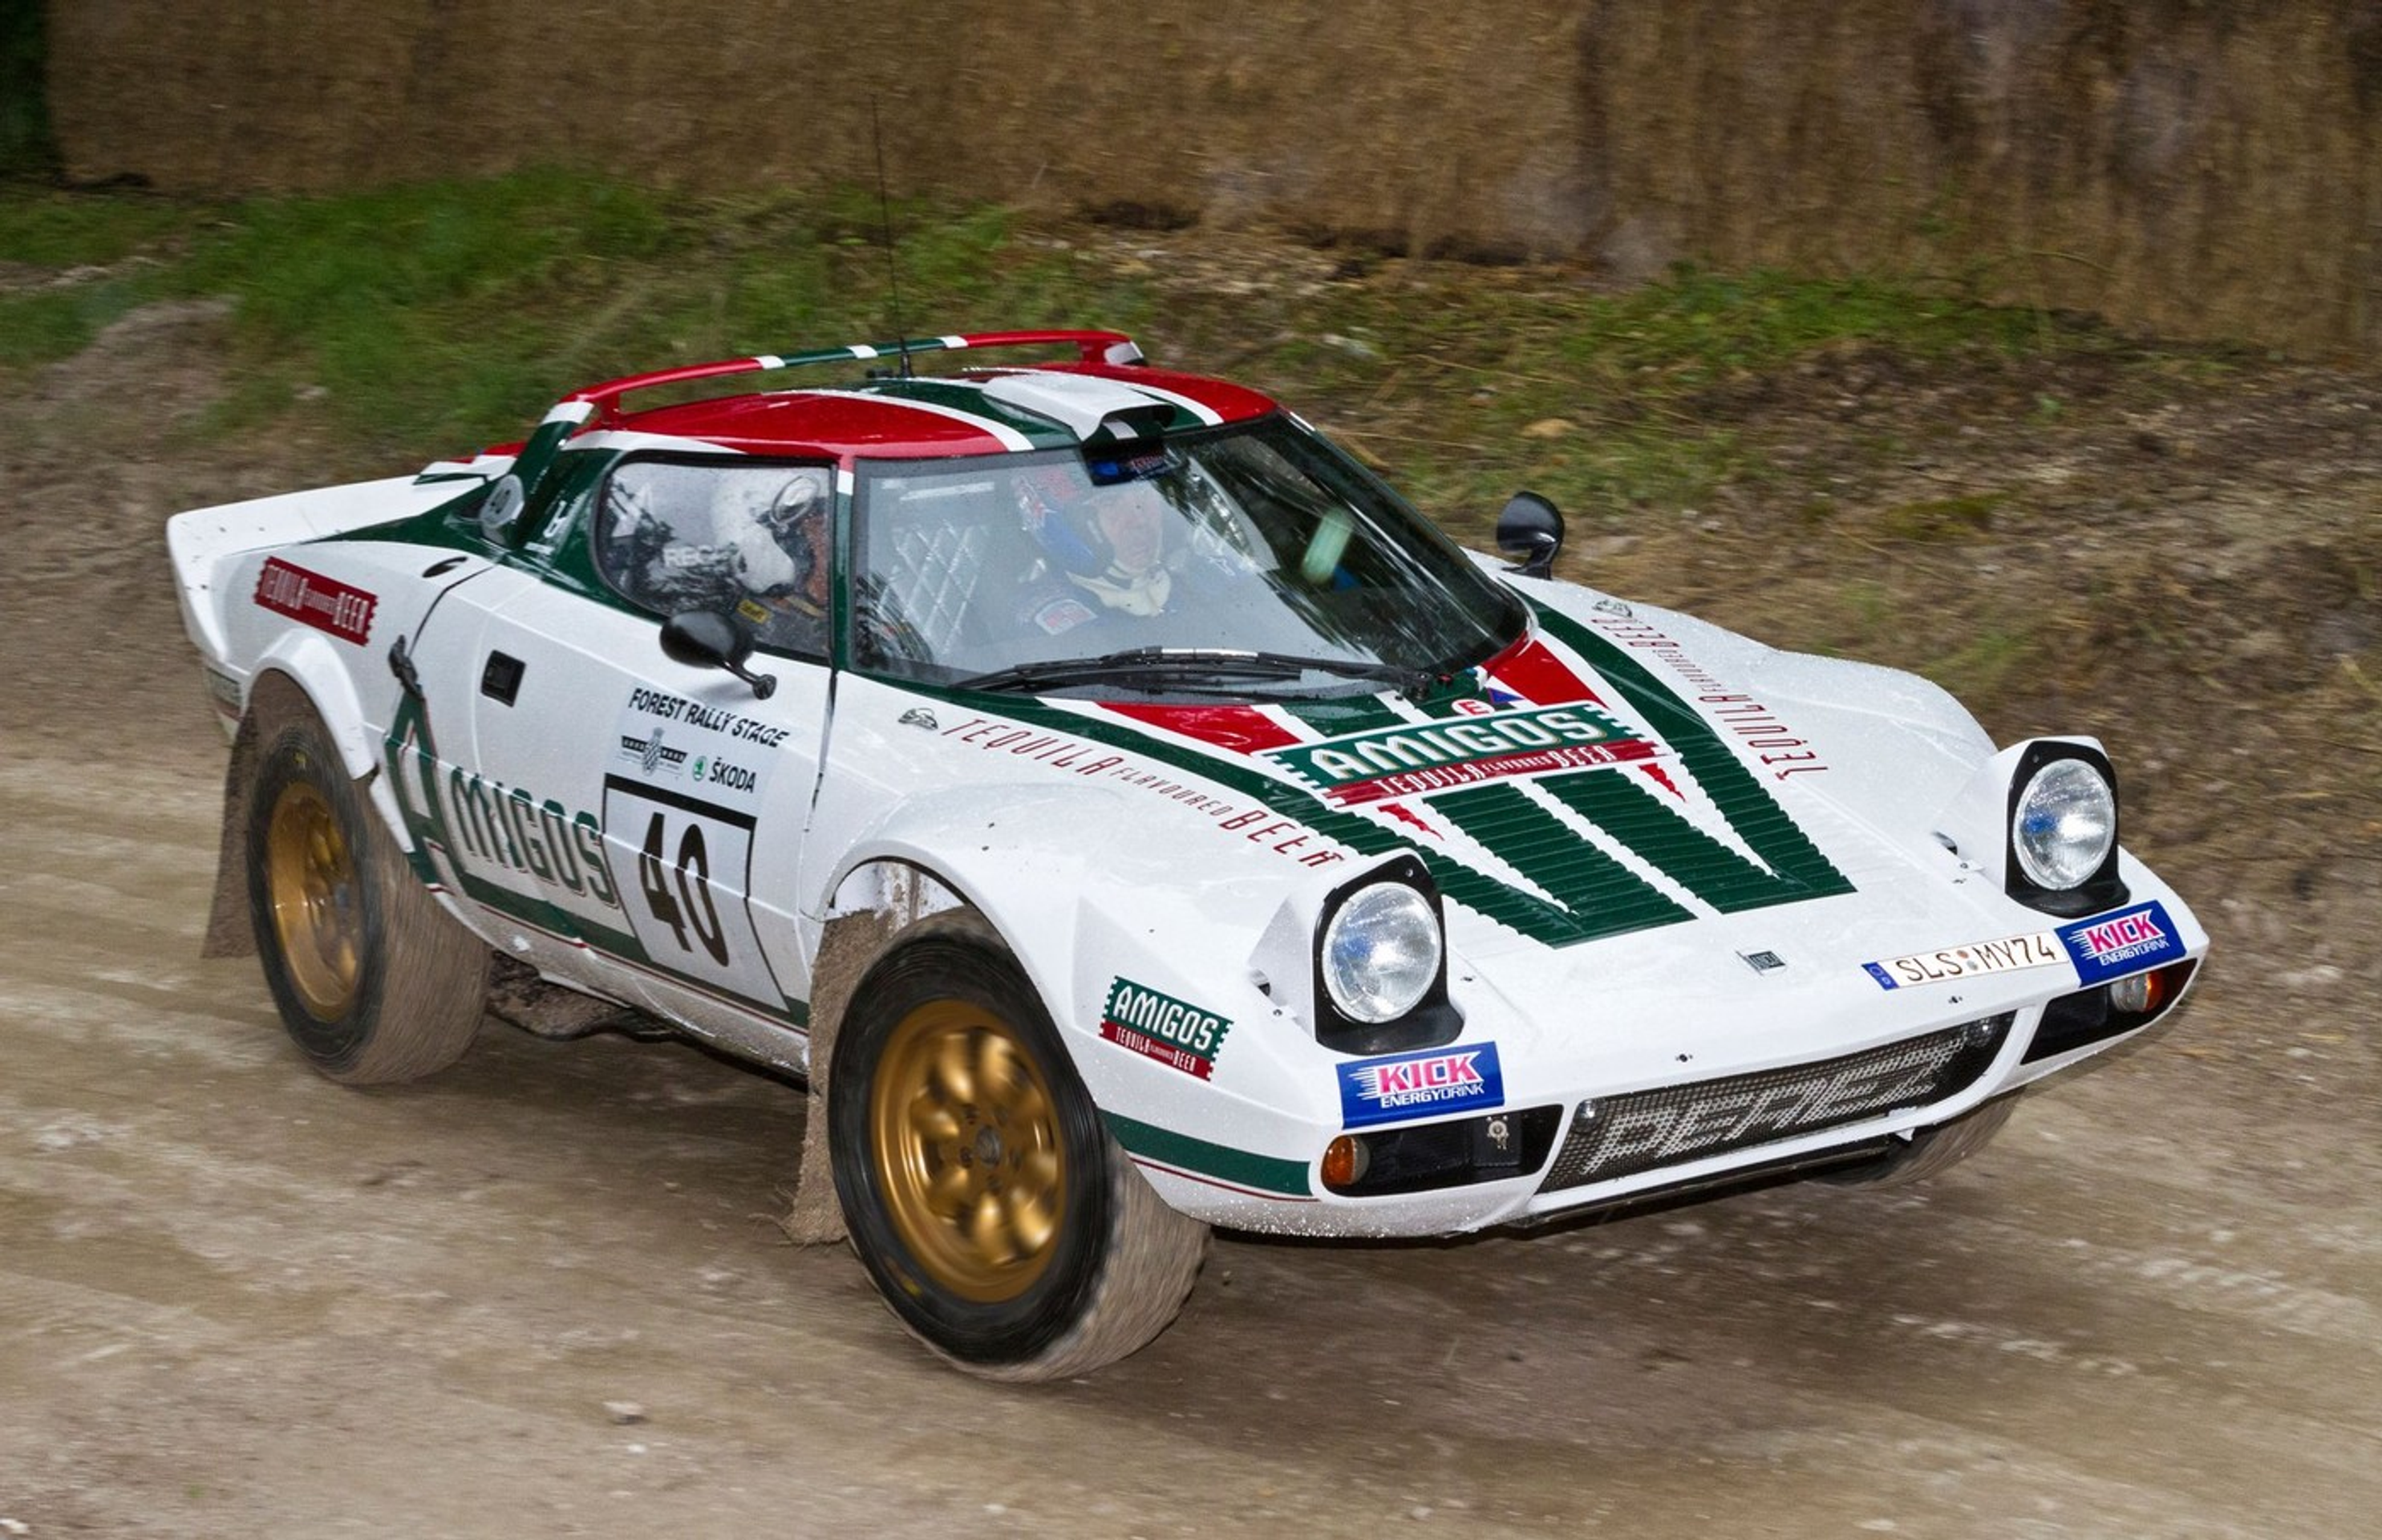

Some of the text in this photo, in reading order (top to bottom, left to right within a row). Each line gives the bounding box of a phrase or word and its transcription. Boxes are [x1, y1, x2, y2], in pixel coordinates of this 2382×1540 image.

[628, 687, 790, 748] FOREST RALLY STAGE
[1458, 700, 1490, 715] E
[1310, 711, 1605, 780] AMIGOS
[709, 756, 756, 793] ŠKODA
[1372, 763, 1485, 796] TEQUILA
[1549, 745, 1617, 768] BEER
[942, 719, 1345, 867] TEQUILA FLAVOURED BEER
[639, 812, 729, 967] 40
[2085, 912, 2162, 954] KICK
[1895, 952, 1963, 982] SLS
[1112, 985, 1219, 1051] AMIGOS
[1173, 1050, 1197, 1072] BEER
[1376, 1053, 1481, 1095] KICK
[1380, 1083, 1485, 1108] ENERGYDRINK
